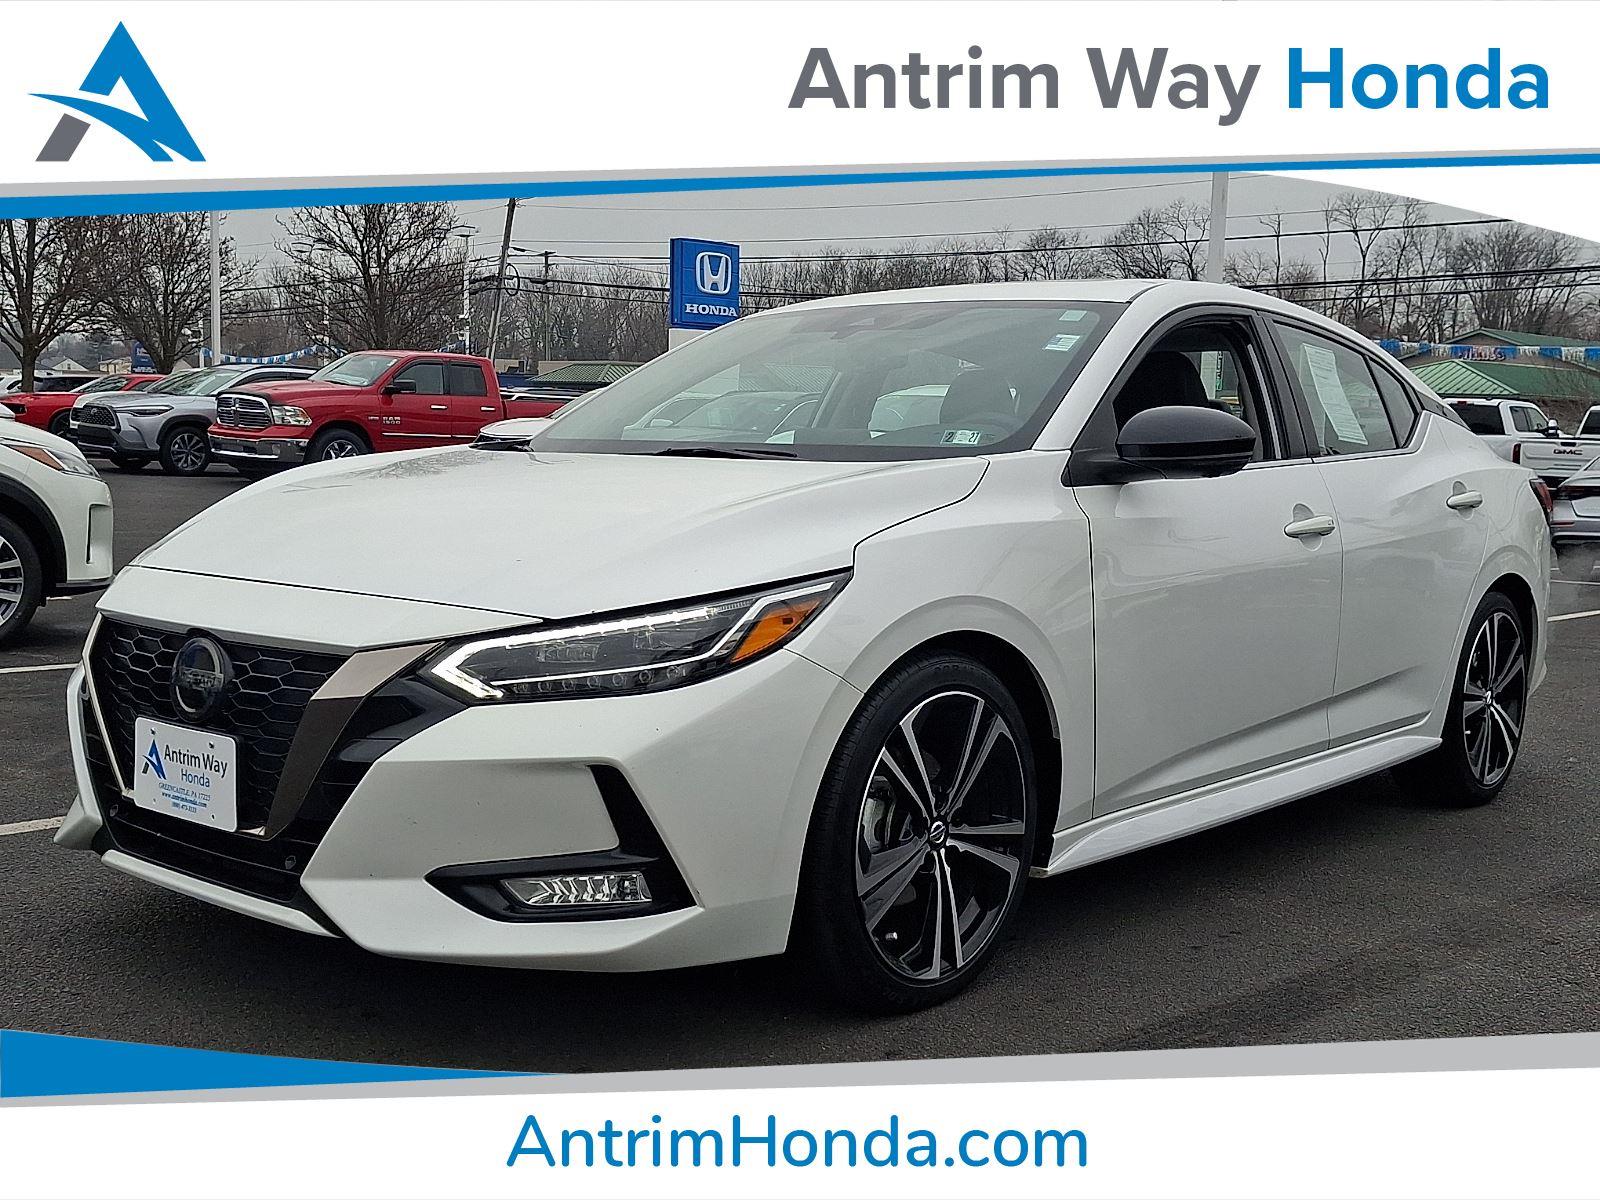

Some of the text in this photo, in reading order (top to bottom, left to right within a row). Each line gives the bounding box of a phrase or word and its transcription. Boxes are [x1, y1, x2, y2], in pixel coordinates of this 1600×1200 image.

[684, 303, 738, 317] HONDA
[1553, 448, 1584, 456] GMC
[164, 744, 228, 779] Antrim Way
[181, 768, 210, 788] Honda
